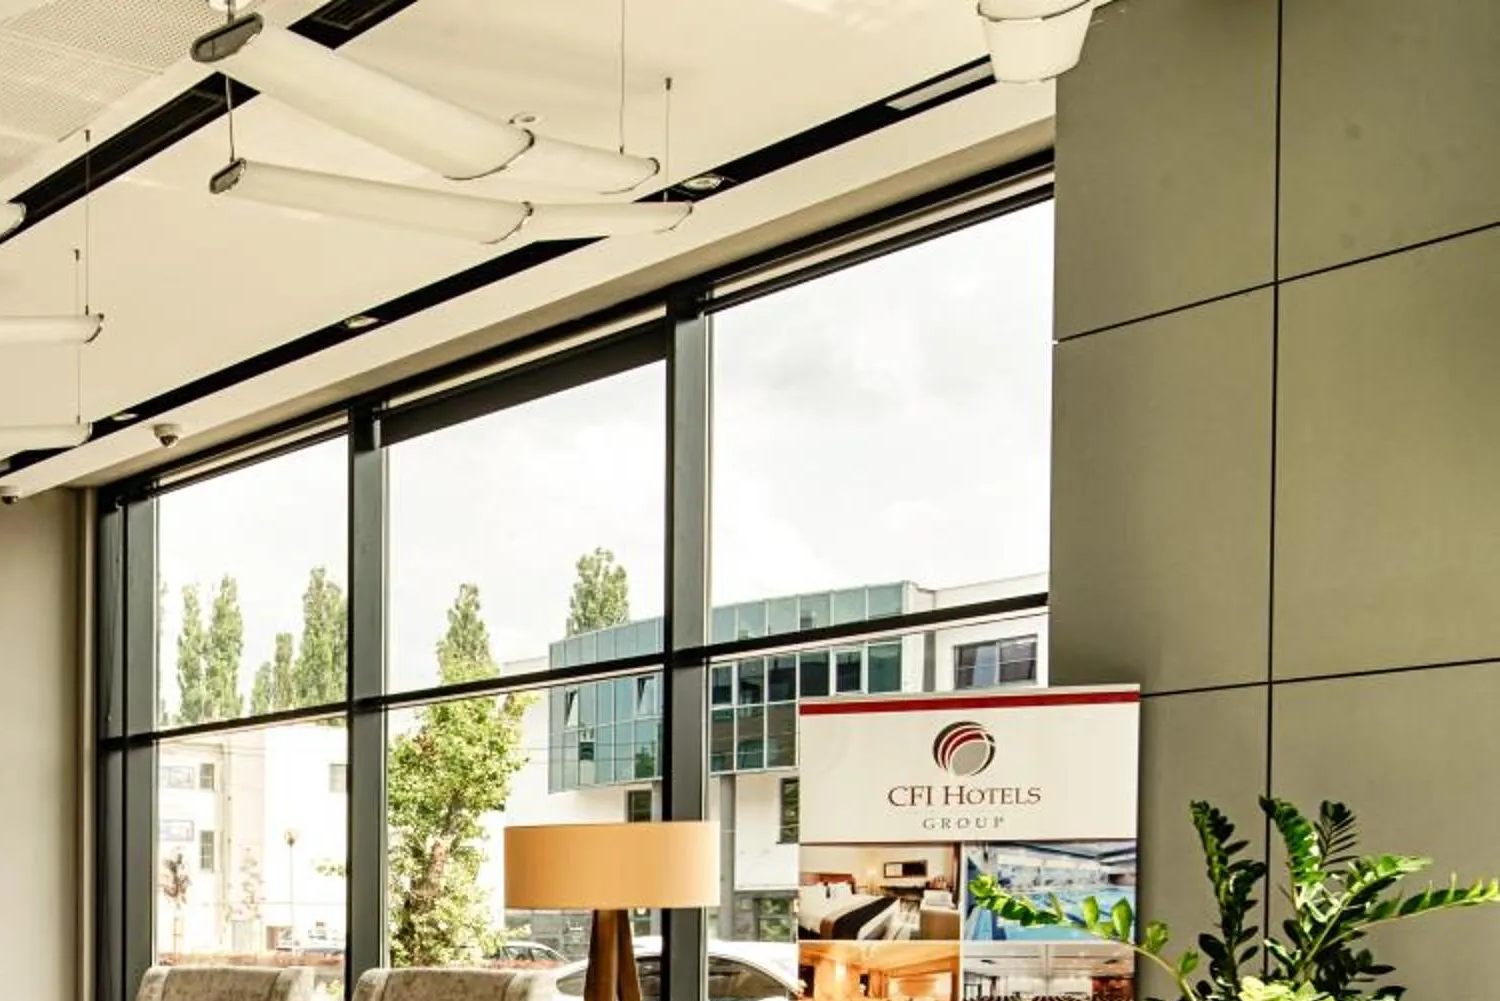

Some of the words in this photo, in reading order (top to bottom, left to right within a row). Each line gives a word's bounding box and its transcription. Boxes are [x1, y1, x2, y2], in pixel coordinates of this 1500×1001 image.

[887, 785, 933, 808] CFI
[943, 784, 1042, 806] HOTELS
[922, 816, 1005, 831] GROUP
